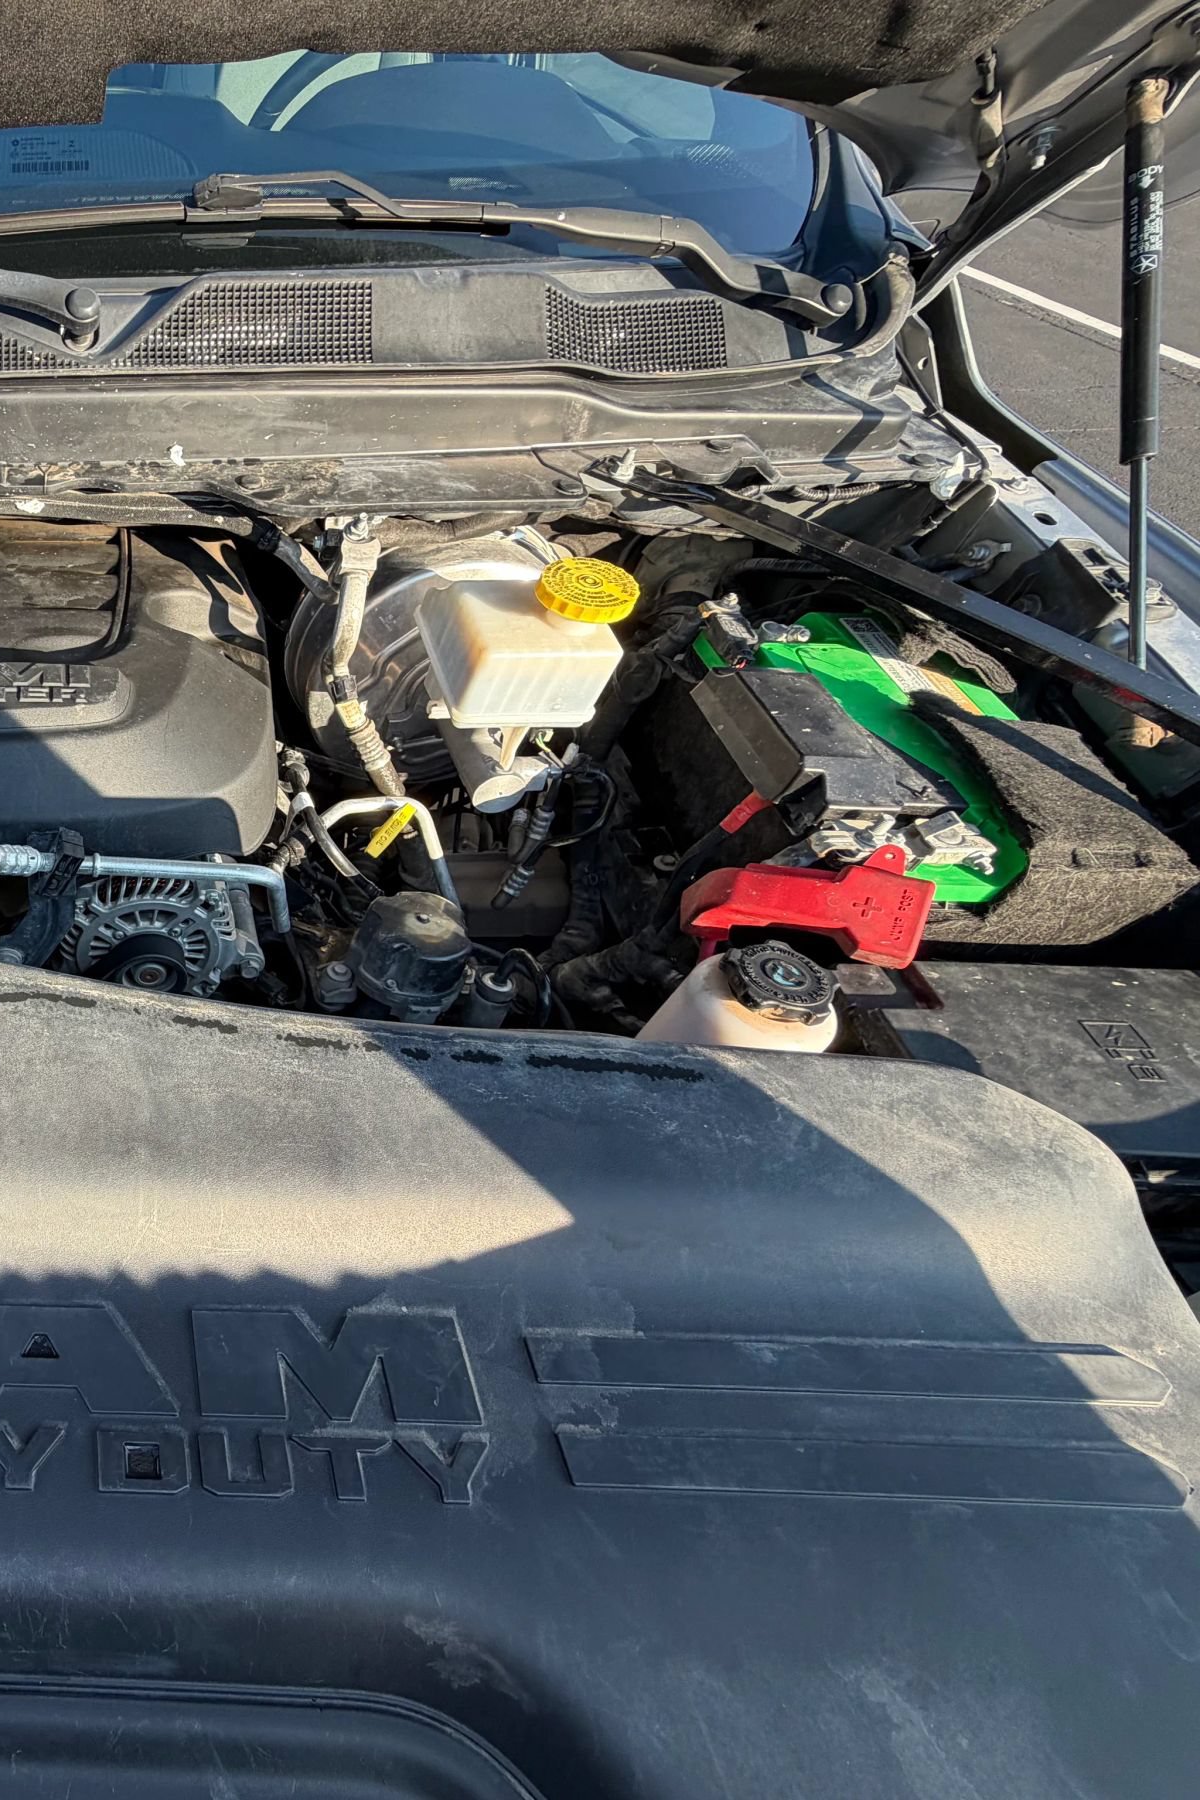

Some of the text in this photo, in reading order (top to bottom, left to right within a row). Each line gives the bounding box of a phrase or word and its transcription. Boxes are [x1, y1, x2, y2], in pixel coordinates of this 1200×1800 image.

[1128, 165, 1164, 184] BODY
[1129, 197, 1138, 258] STABILUS
[897, 889, 914, 912] POST
[96, 1425, 492, 1505] DUTY
